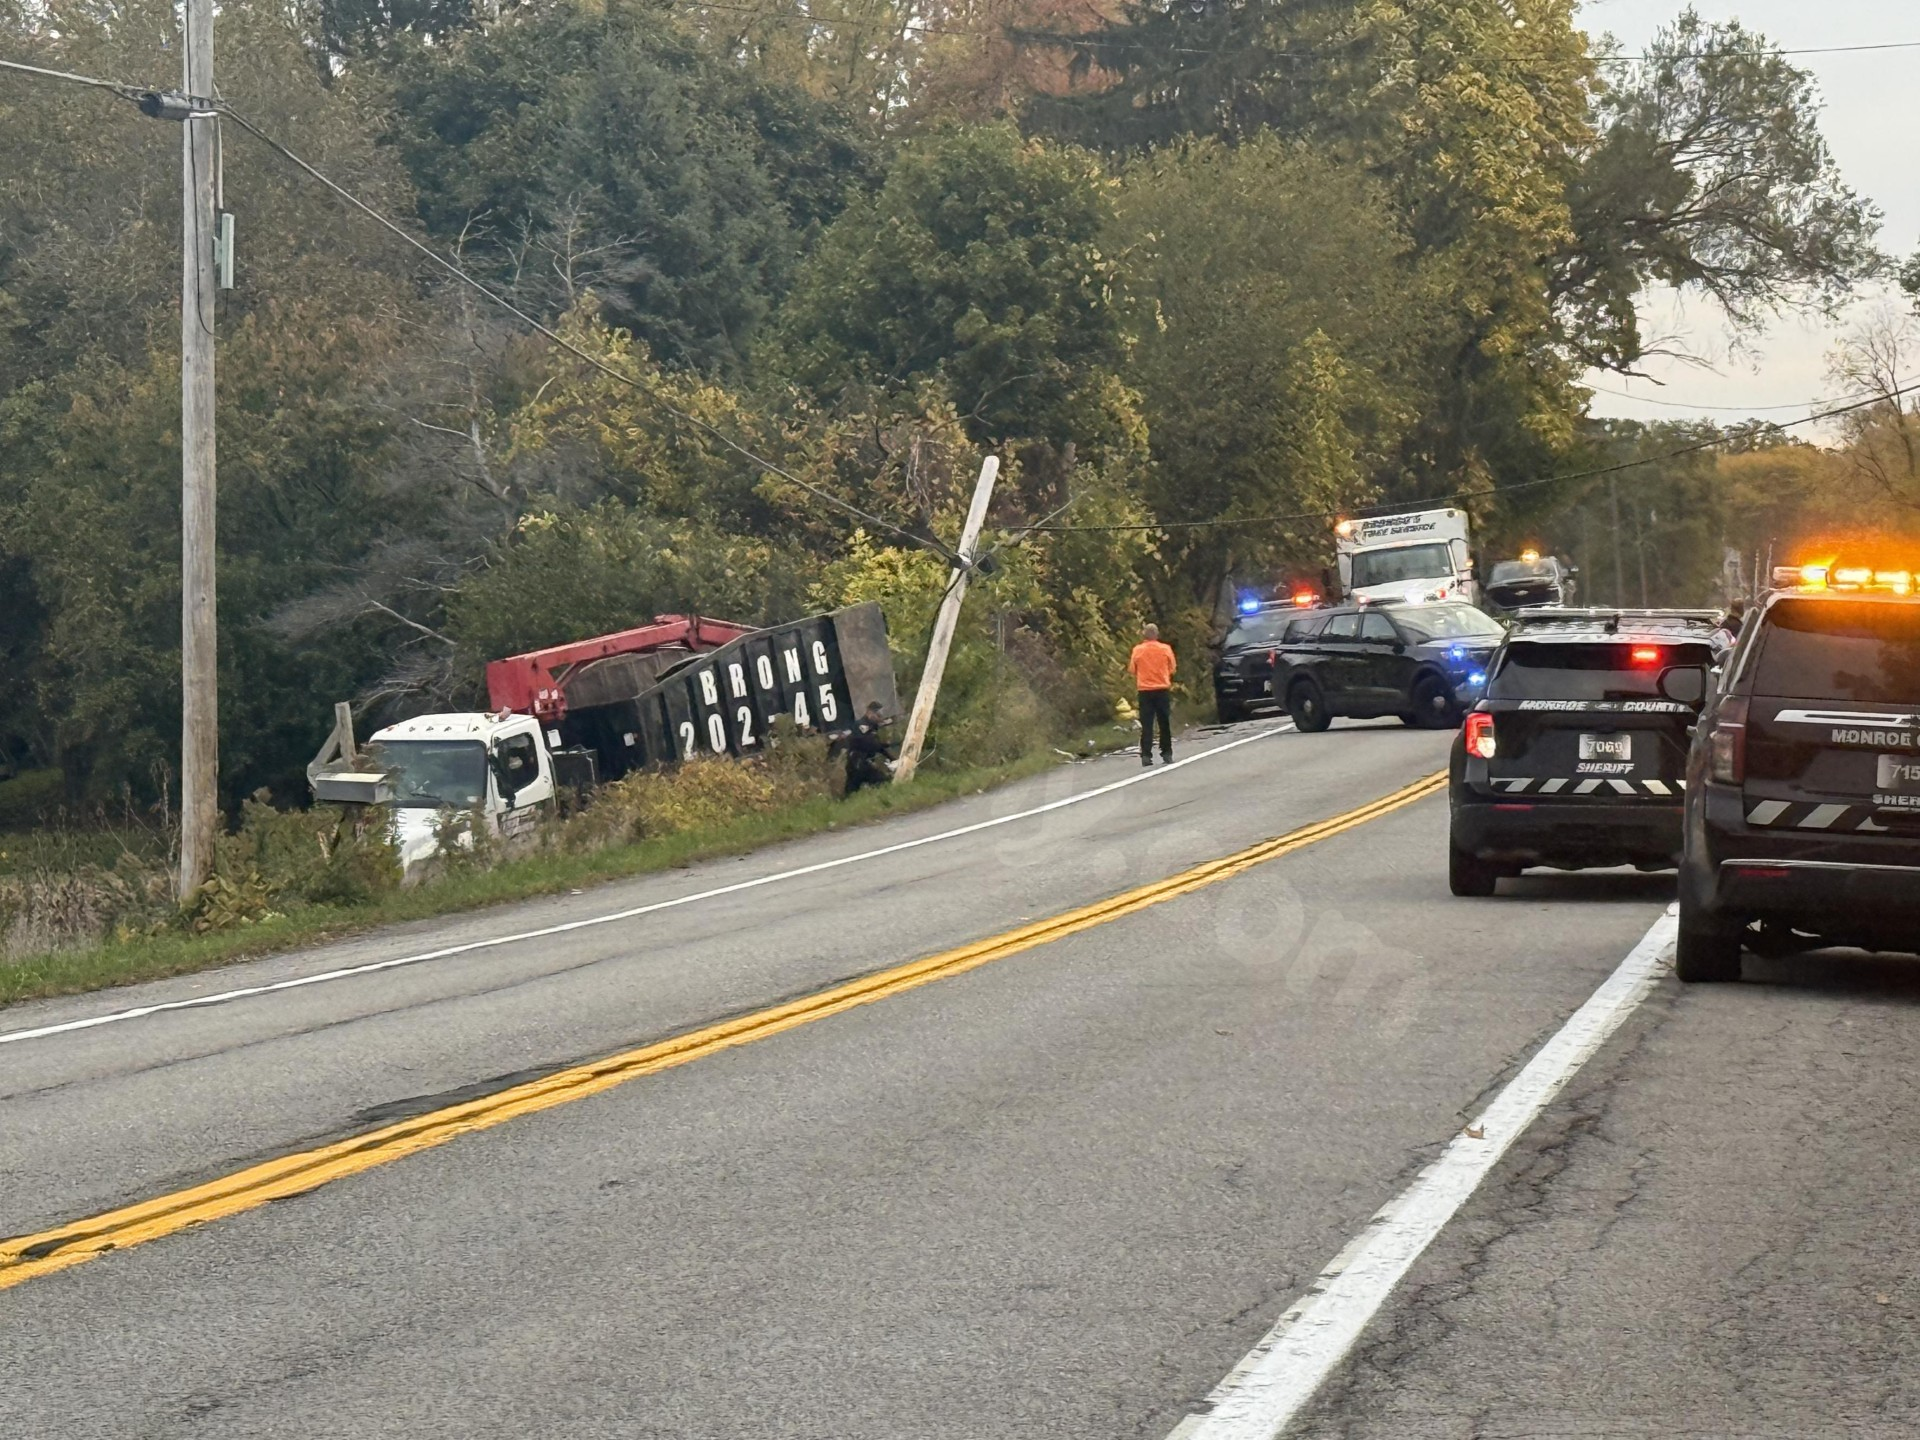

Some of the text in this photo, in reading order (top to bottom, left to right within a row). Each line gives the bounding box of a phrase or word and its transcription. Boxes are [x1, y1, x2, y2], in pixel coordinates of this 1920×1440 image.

[700, 640, 829, 705] BRONG
[1518, 701, 1588, 711] MONROE
[1832, 729, 1912, 747] MONROE
[1576, 763, 1635, 774] SHERIFF
